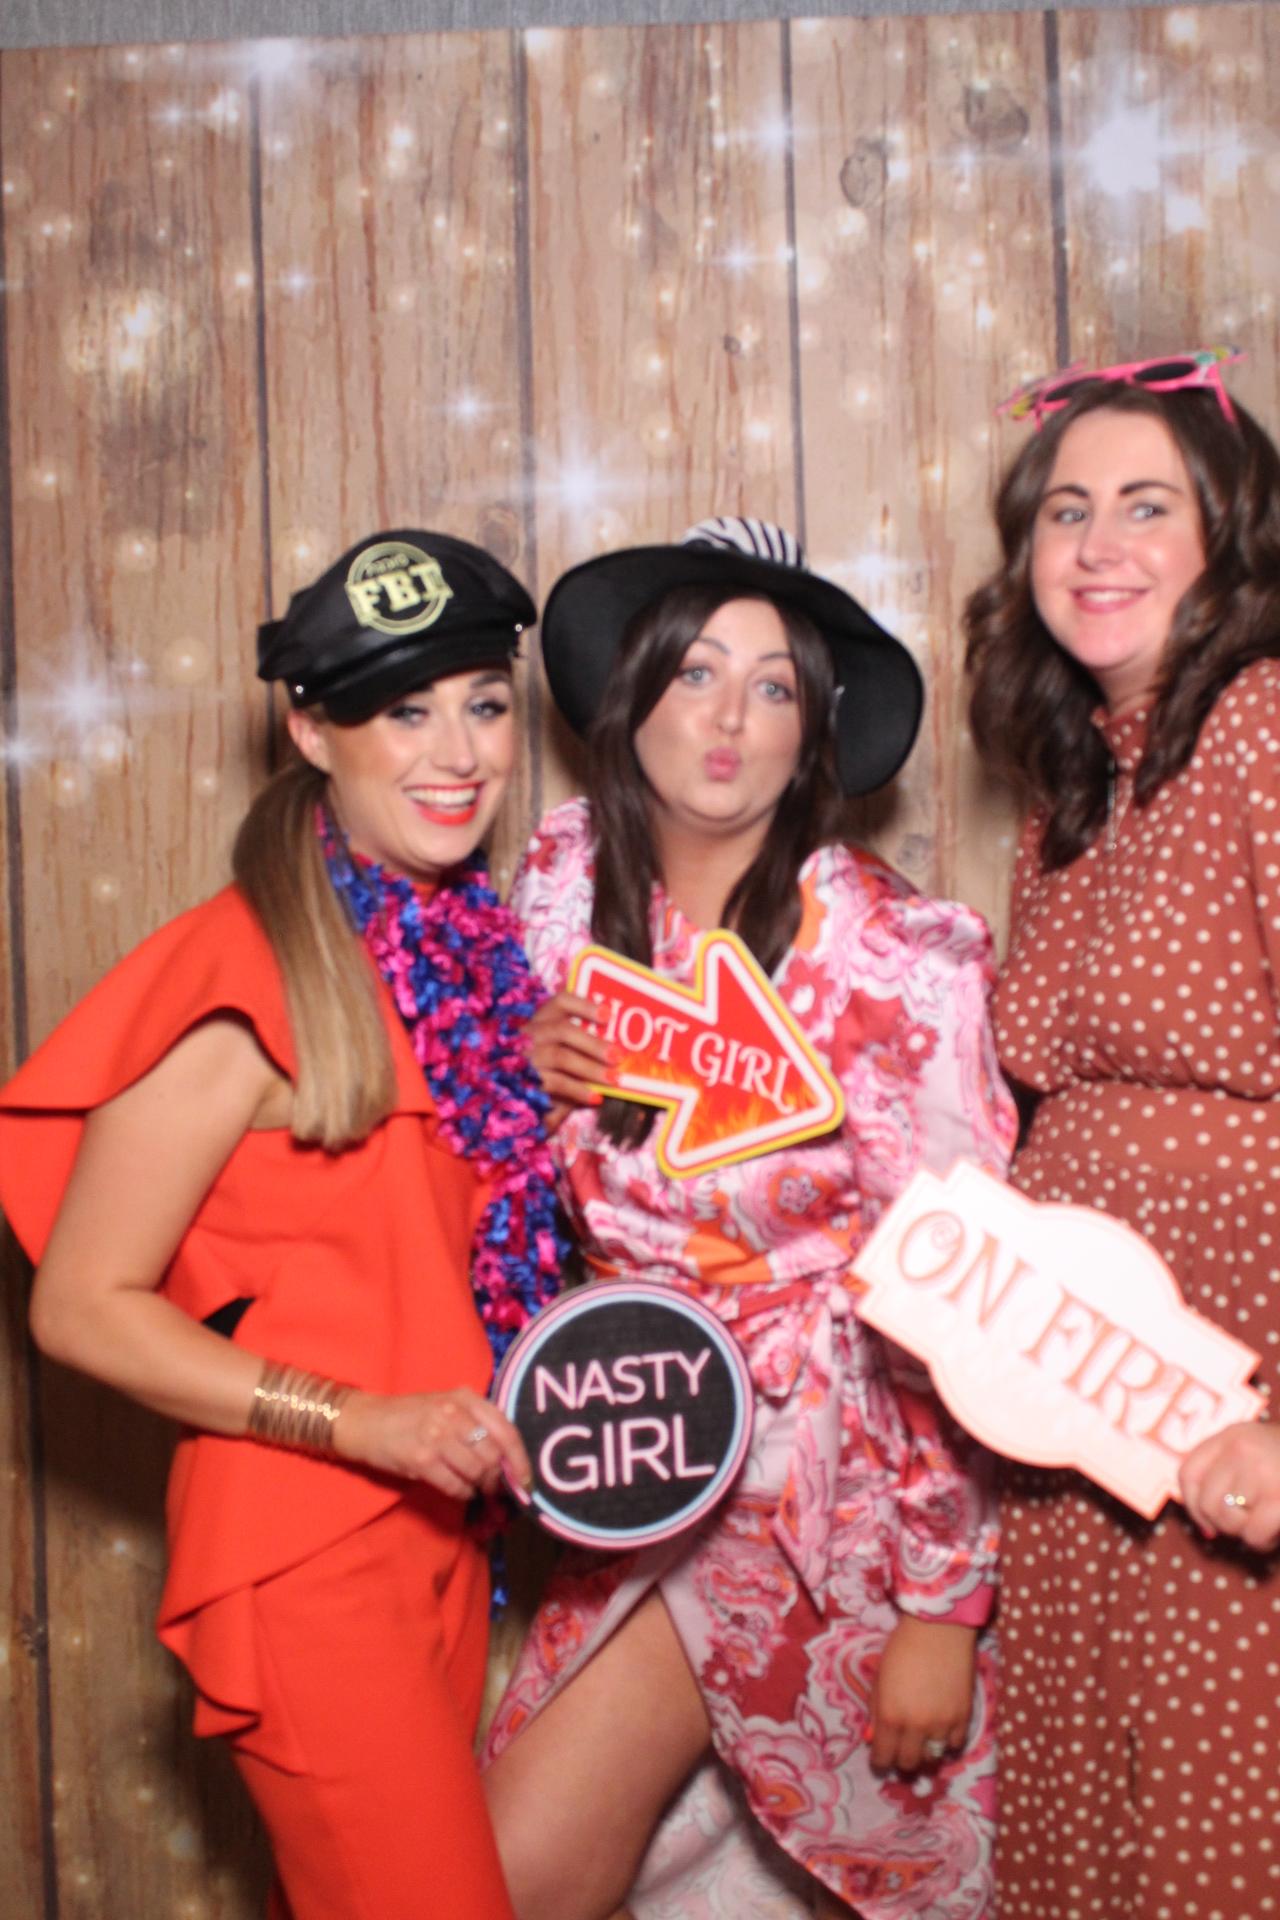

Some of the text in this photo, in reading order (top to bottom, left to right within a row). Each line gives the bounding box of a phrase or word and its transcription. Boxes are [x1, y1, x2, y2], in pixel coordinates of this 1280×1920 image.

[344, 557, 454, 627] FBI
[691, 1031, 795, 1113] GIRL
[896, 1208, 1225, 1459] ON FIRE
[534, 1347, 711, 1414] NASTY
[539, 1412, 716, 1493] GIRL
